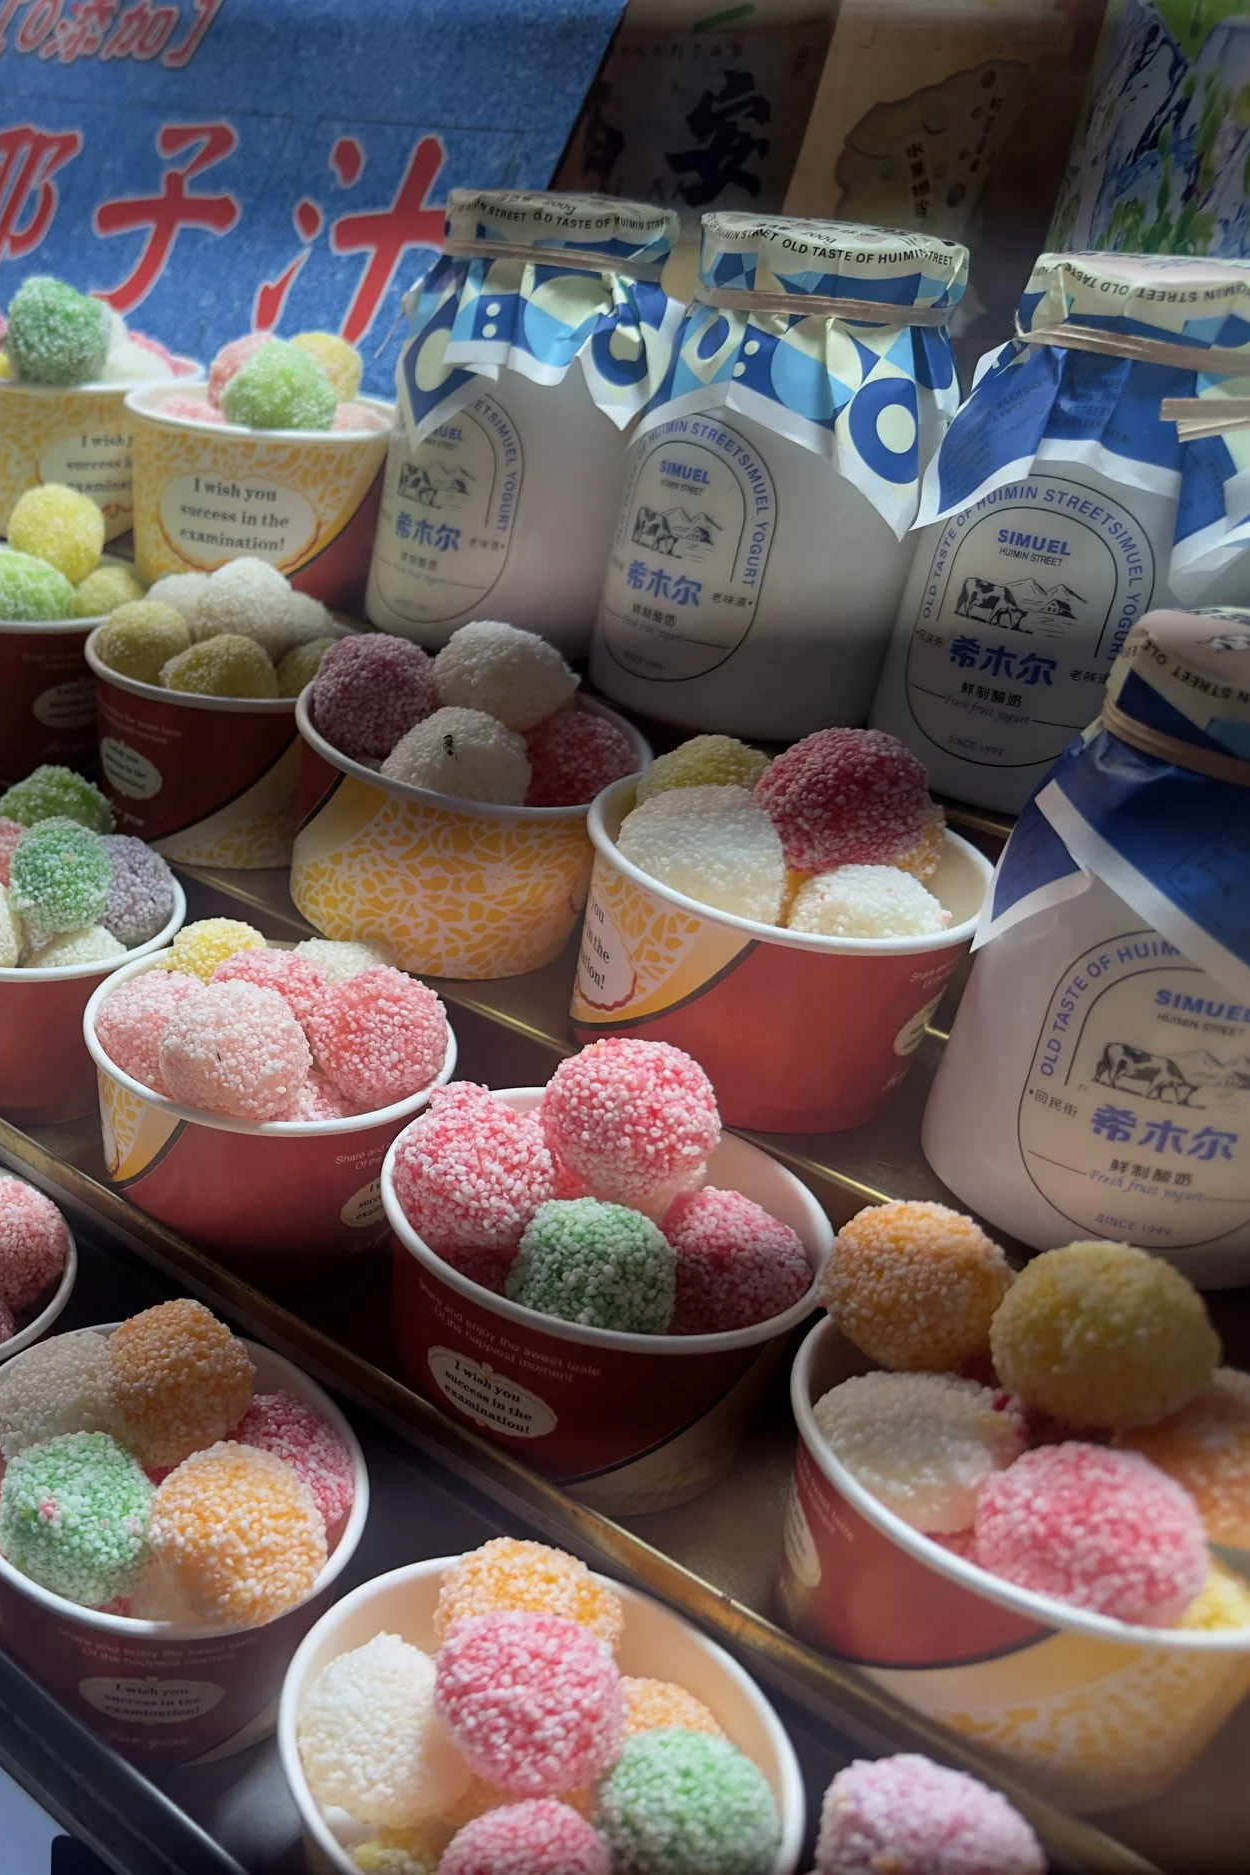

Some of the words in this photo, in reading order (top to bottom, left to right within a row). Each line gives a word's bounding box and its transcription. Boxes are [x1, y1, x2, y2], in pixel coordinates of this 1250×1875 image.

[665, 70, 771, 208] 安
[557, 216, 592, 229] TASTE
[595, 217, 612, 229] OF
[782, 238, 808, 255] OLD
[812, 246, 852, 262] TASTE
[856, 253, 874, 264] OF
[878, 248, 928, 264] HUIMIN
[928, 250, 953, 266] TREET
[1100, 282, 1130, 296] OLD
[659, 460, 710, 485] SIMUEL
[194, 478, 200, 493] I
[204, 482, 241, 498] wish
[244, 488, 277, 502] you
[497, 472, 518, 533] YOGURT
[180, 504, 237, 522] success
[241, 511, 258, 526] in
[262, 513, 290, 528] the
[180, 528, 286, 551] examination!
[923, 587, 938, 619] OLD
[934, 529, 957, 579] TASTE
[956, 509, 973, 527] OF
[976, 486, 1039, 511] HUIMIN
[998, 529, 1071, 556] SIMUEL
[742, 521, 769, 588] YOGURT
[999, 547, 1029, 561] HUIMIN
[1031, 553, 1063, 567] STREET
[961, 681, 1022, 708] 鲜制酸奶
[1171, 665, 1233, 699] STREET
[947, 735, 977, 750] SINCE
[593, 935, 610, 964] the
[1040, 1038, 1062, 1077] OLD
[1052, 975, 1089, 1033] TASTE
[1086, 954, 1111, 978] OF
[1116, 940, 1181, 963] HUIM
[1034, 1089, 1079, 1118] 回民街
[335, 1151, 366, 1166] Share
[355, 1159, 367, 1171] Of
[1110, 1158, 1193, 1187] 鲜制酸奶
[1095, 1213, 1137, 1231] SINCE
[444, 1303, 463, 1322] and
[465, 1318, 497, 1343] enjoy
[500, 1335, 520, 1352] the
[523, 1347, 565, 1368] sweet
[567, 1358, 602, 1377] taste
[447, 1316, 463, 1334] the
[518, 1355, 575, 1383] moment
[454, 1361, 461, 1371] I
[463, 1367, 492, 1391] wish
[495, 1385, 521, 1403] you
[444, 1384, 530, 1434] examination!
[445, 1370, 490, 1402] success
[492, 1395, 506, 1412] in
[509, 1404, 533, 1422] the
[95, 1641, 120, 1654] and
[115, 1684, 121, 1692] I
[123, 1687, 158, 1696] wish
[162, 1687, 189, 1698] you
[104, 1705, 201, 1718] examination!
